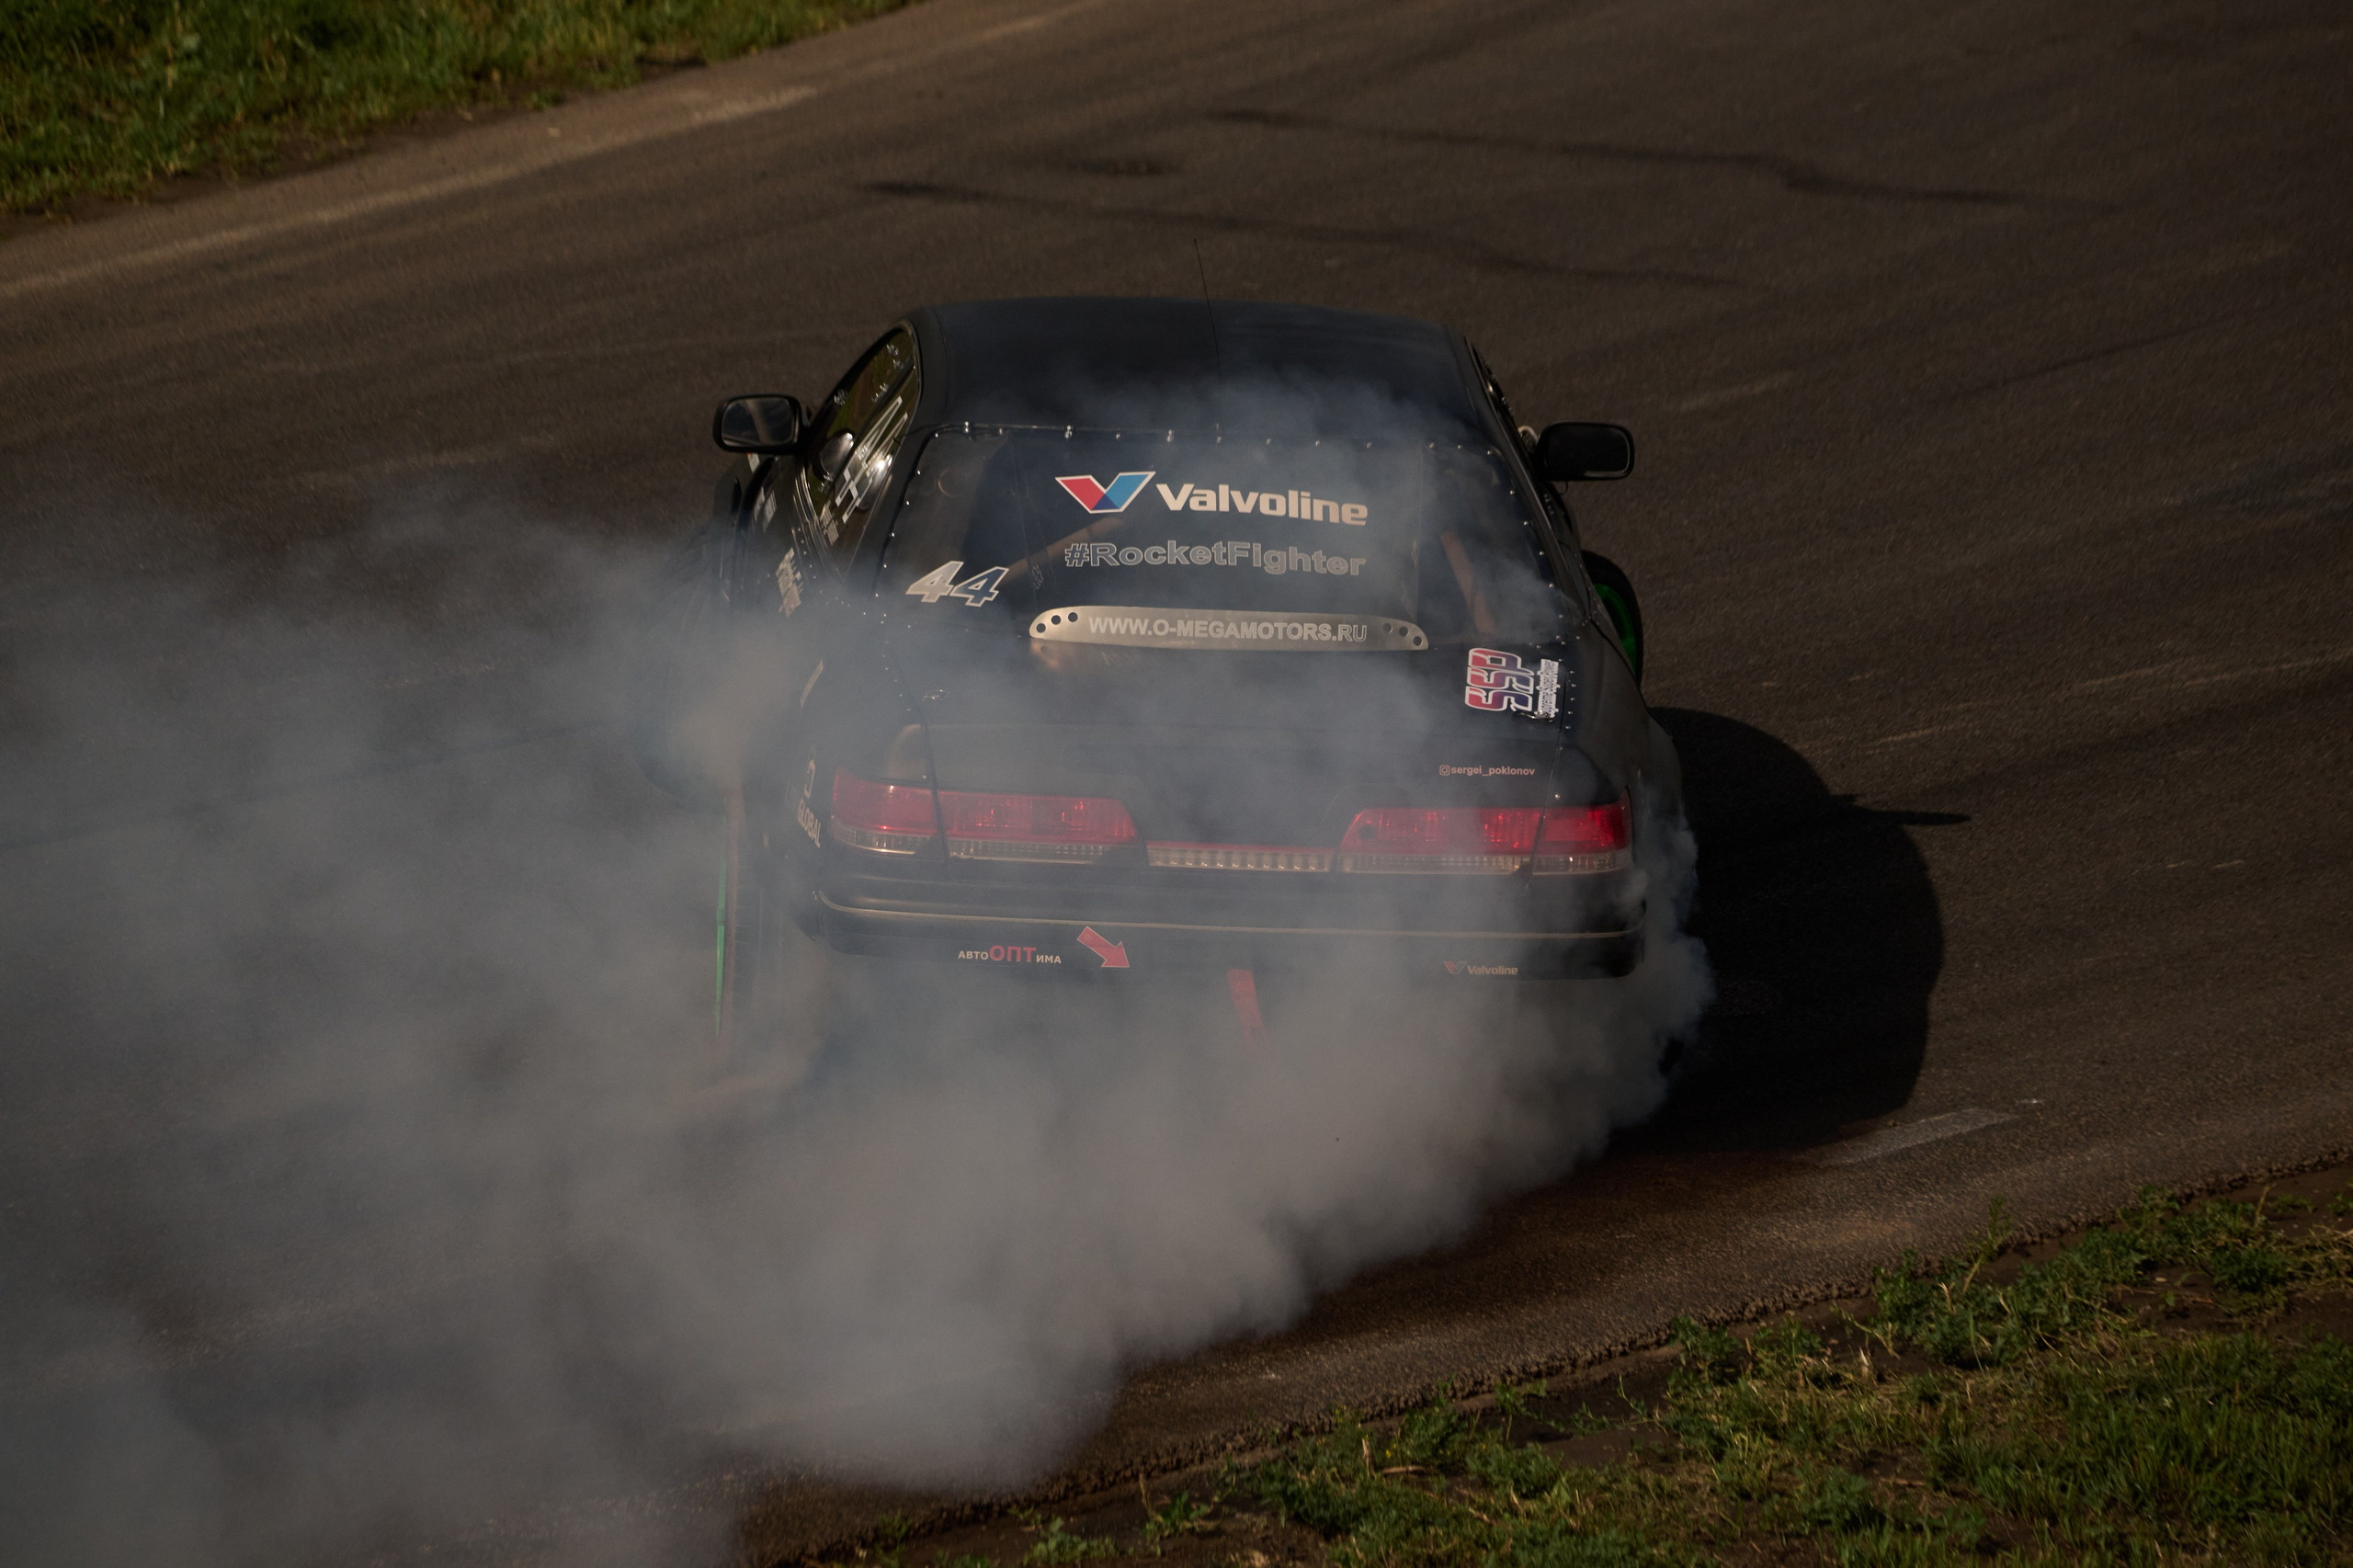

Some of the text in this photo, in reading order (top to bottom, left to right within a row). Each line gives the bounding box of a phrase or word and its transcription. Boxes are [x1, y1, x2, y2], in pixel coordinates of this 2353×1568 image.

[1156, 483, 1368, 526] Valvoline
[905, 561, 1009, 608] 44
[1089, 615, 1368, 642] WWW.O-MEGAMOTORS.RU
[1450, 765, 1536, 777] sergei_poklonov
[1466, 965, 1518, 975] Valvoline
